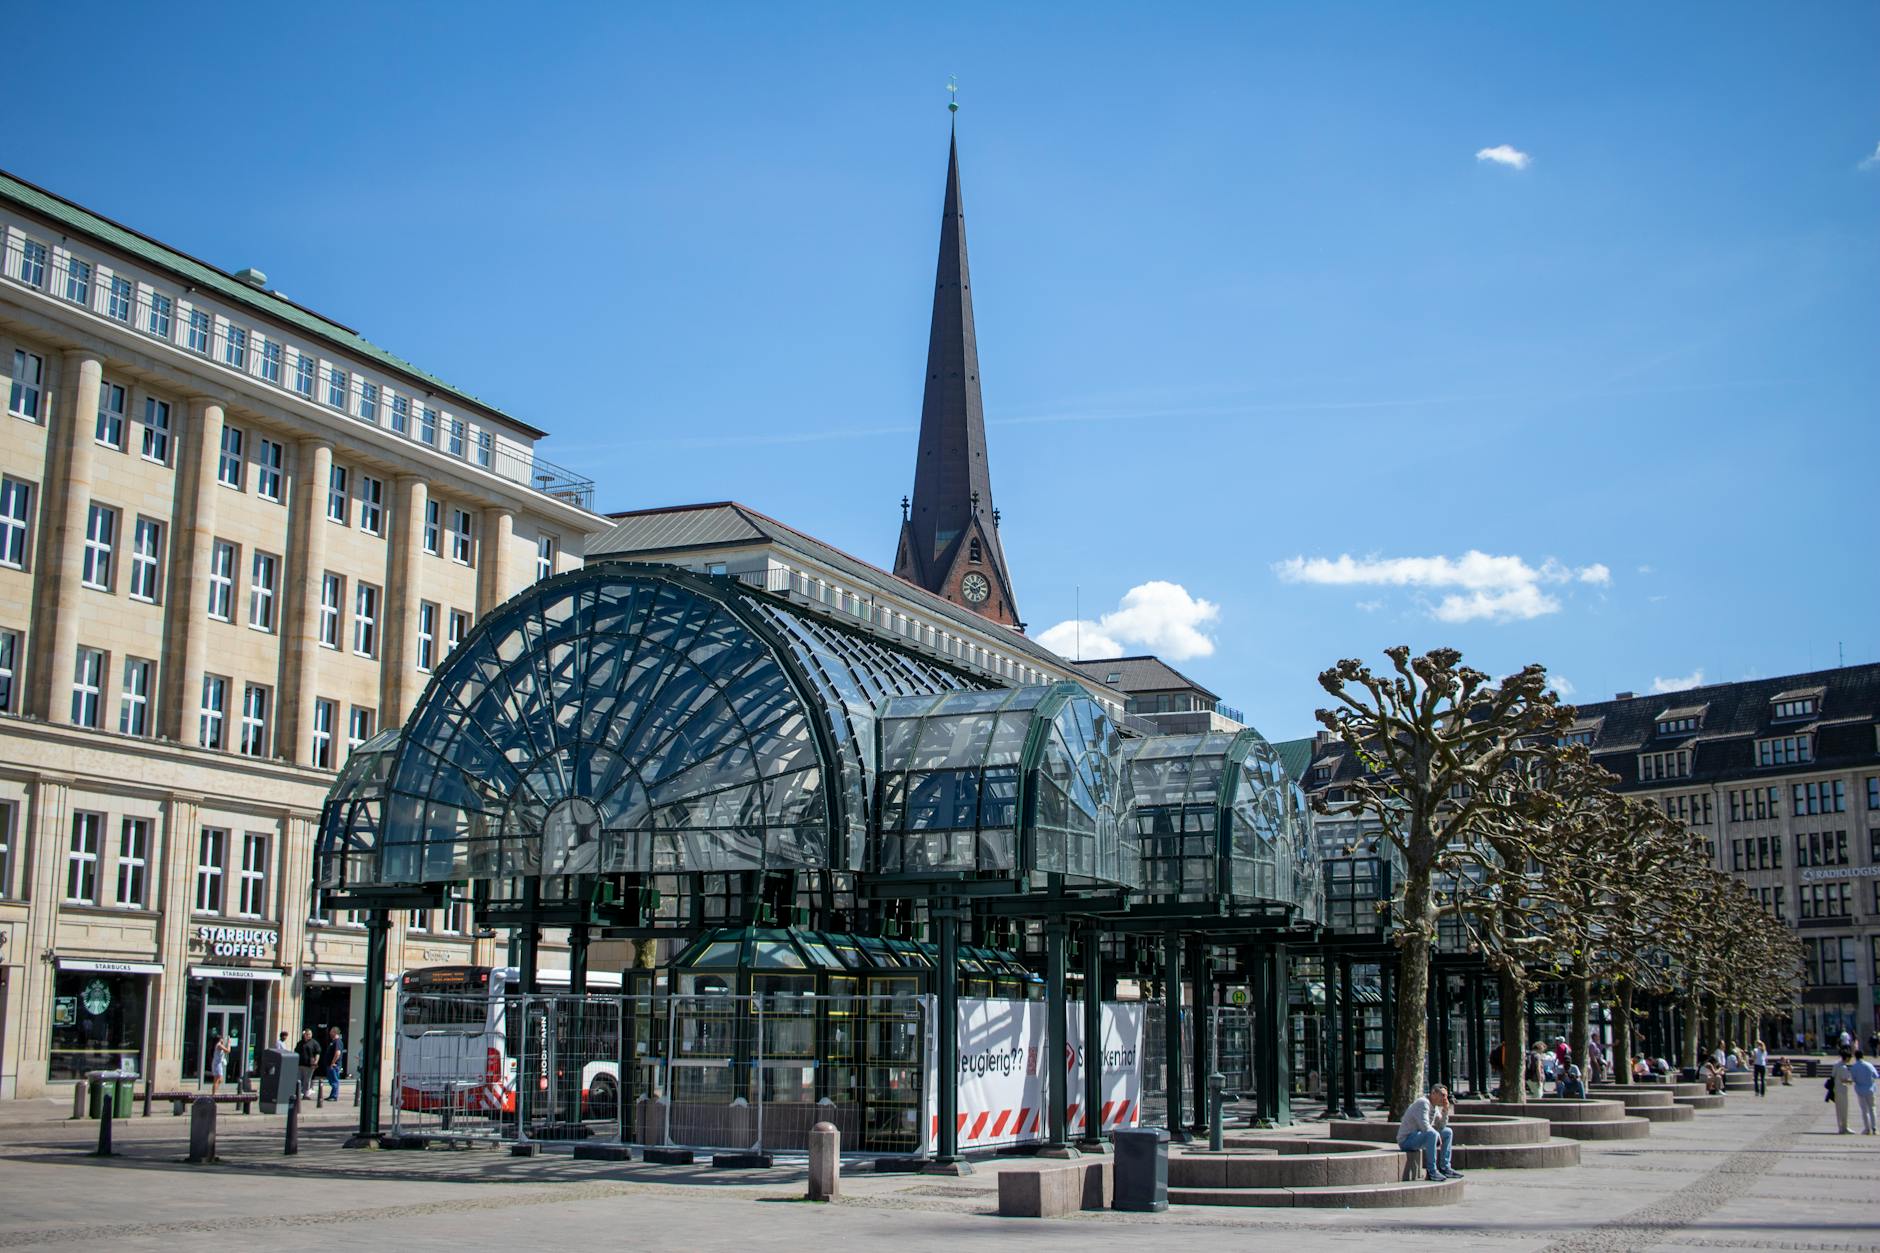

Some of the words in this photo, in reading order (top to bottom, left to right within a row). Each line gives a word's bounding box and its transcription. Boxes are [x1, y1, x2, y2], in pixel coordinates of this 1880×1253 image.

[1816, 866, 1880, 880] RADIOLOGIS
[200, 927, 278, 944] STARBUCKS
[214, 942, 265, 958] COFFEE
[95, 963, 131, 971] STARBUCKS
[222, 970, 254, 978] STARBUCKS
